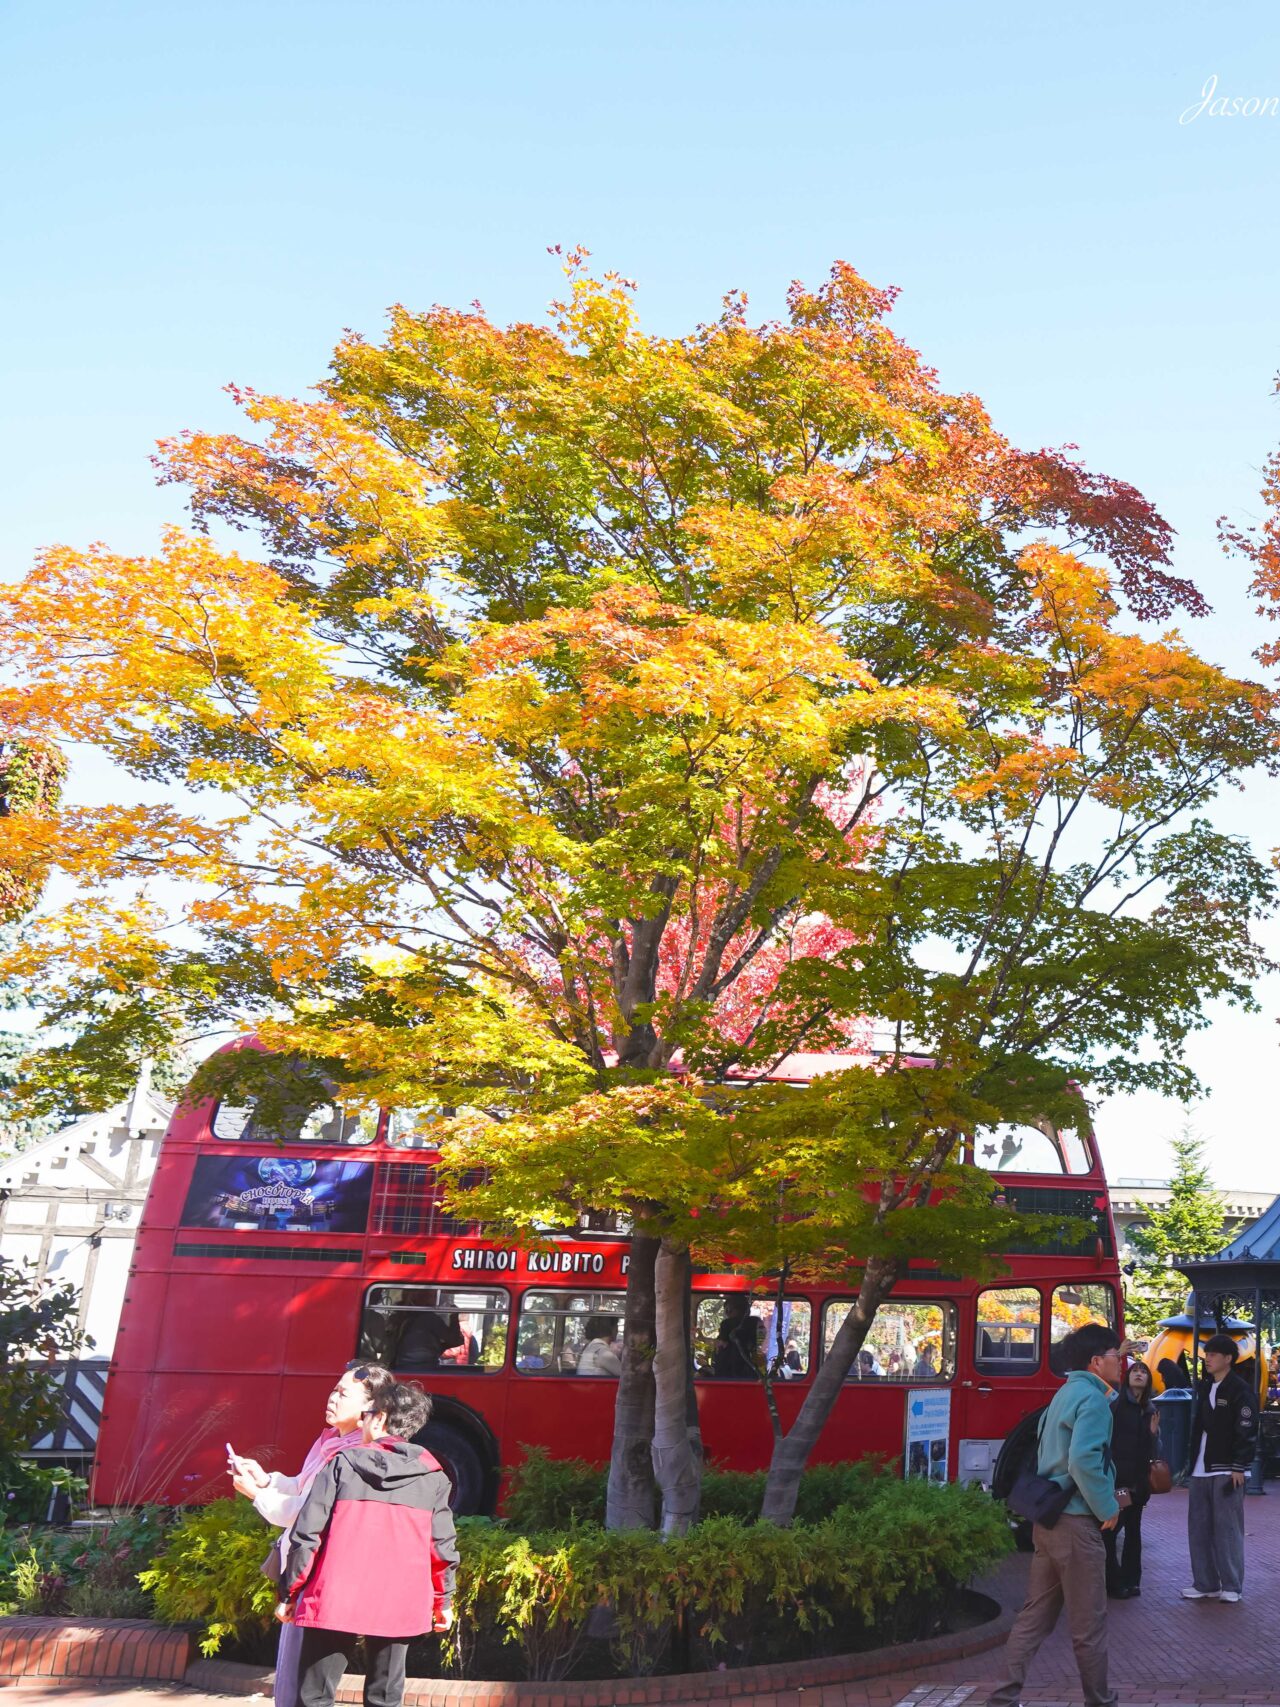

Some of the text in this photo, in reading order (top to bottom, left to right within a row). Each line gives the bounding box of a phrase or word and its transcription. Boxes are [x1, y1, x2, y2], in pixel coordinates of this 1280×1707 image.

[240, 1181, 315, 1205] CHOCOTOPIA
[452, 1249, 517, 1270] SHIROI
[527, 1251, 604, 1273] KOIBITO
